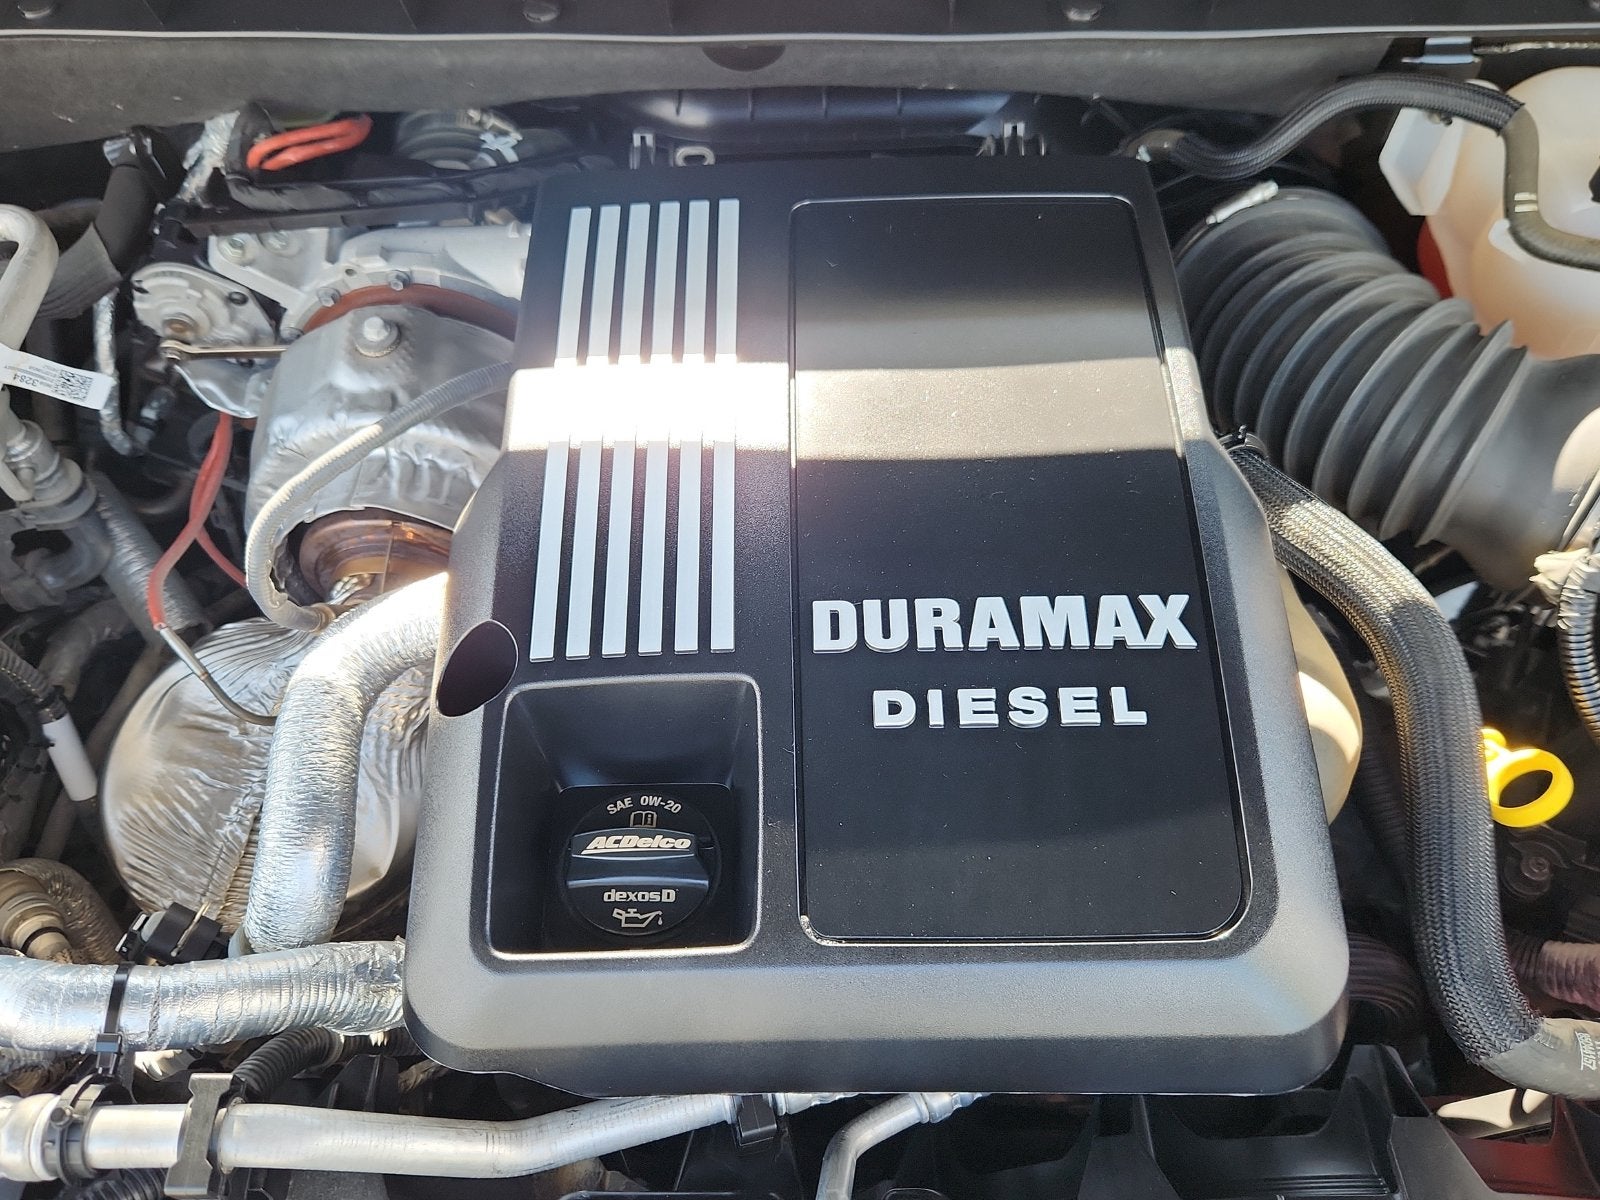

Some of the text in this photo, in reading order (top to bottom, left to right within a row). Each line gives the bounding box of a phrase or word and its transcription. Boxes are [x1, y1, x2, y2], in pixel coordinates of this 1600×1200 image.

[812, 594, 1198, 654] DURAMAX
[872, 686, 1148, 729] DIESEL
[606, 795, 682, 815] SAE 0W-20
[585, 834, 692, 850] ACDelco
[603, 888, 676, 903] dexosD
